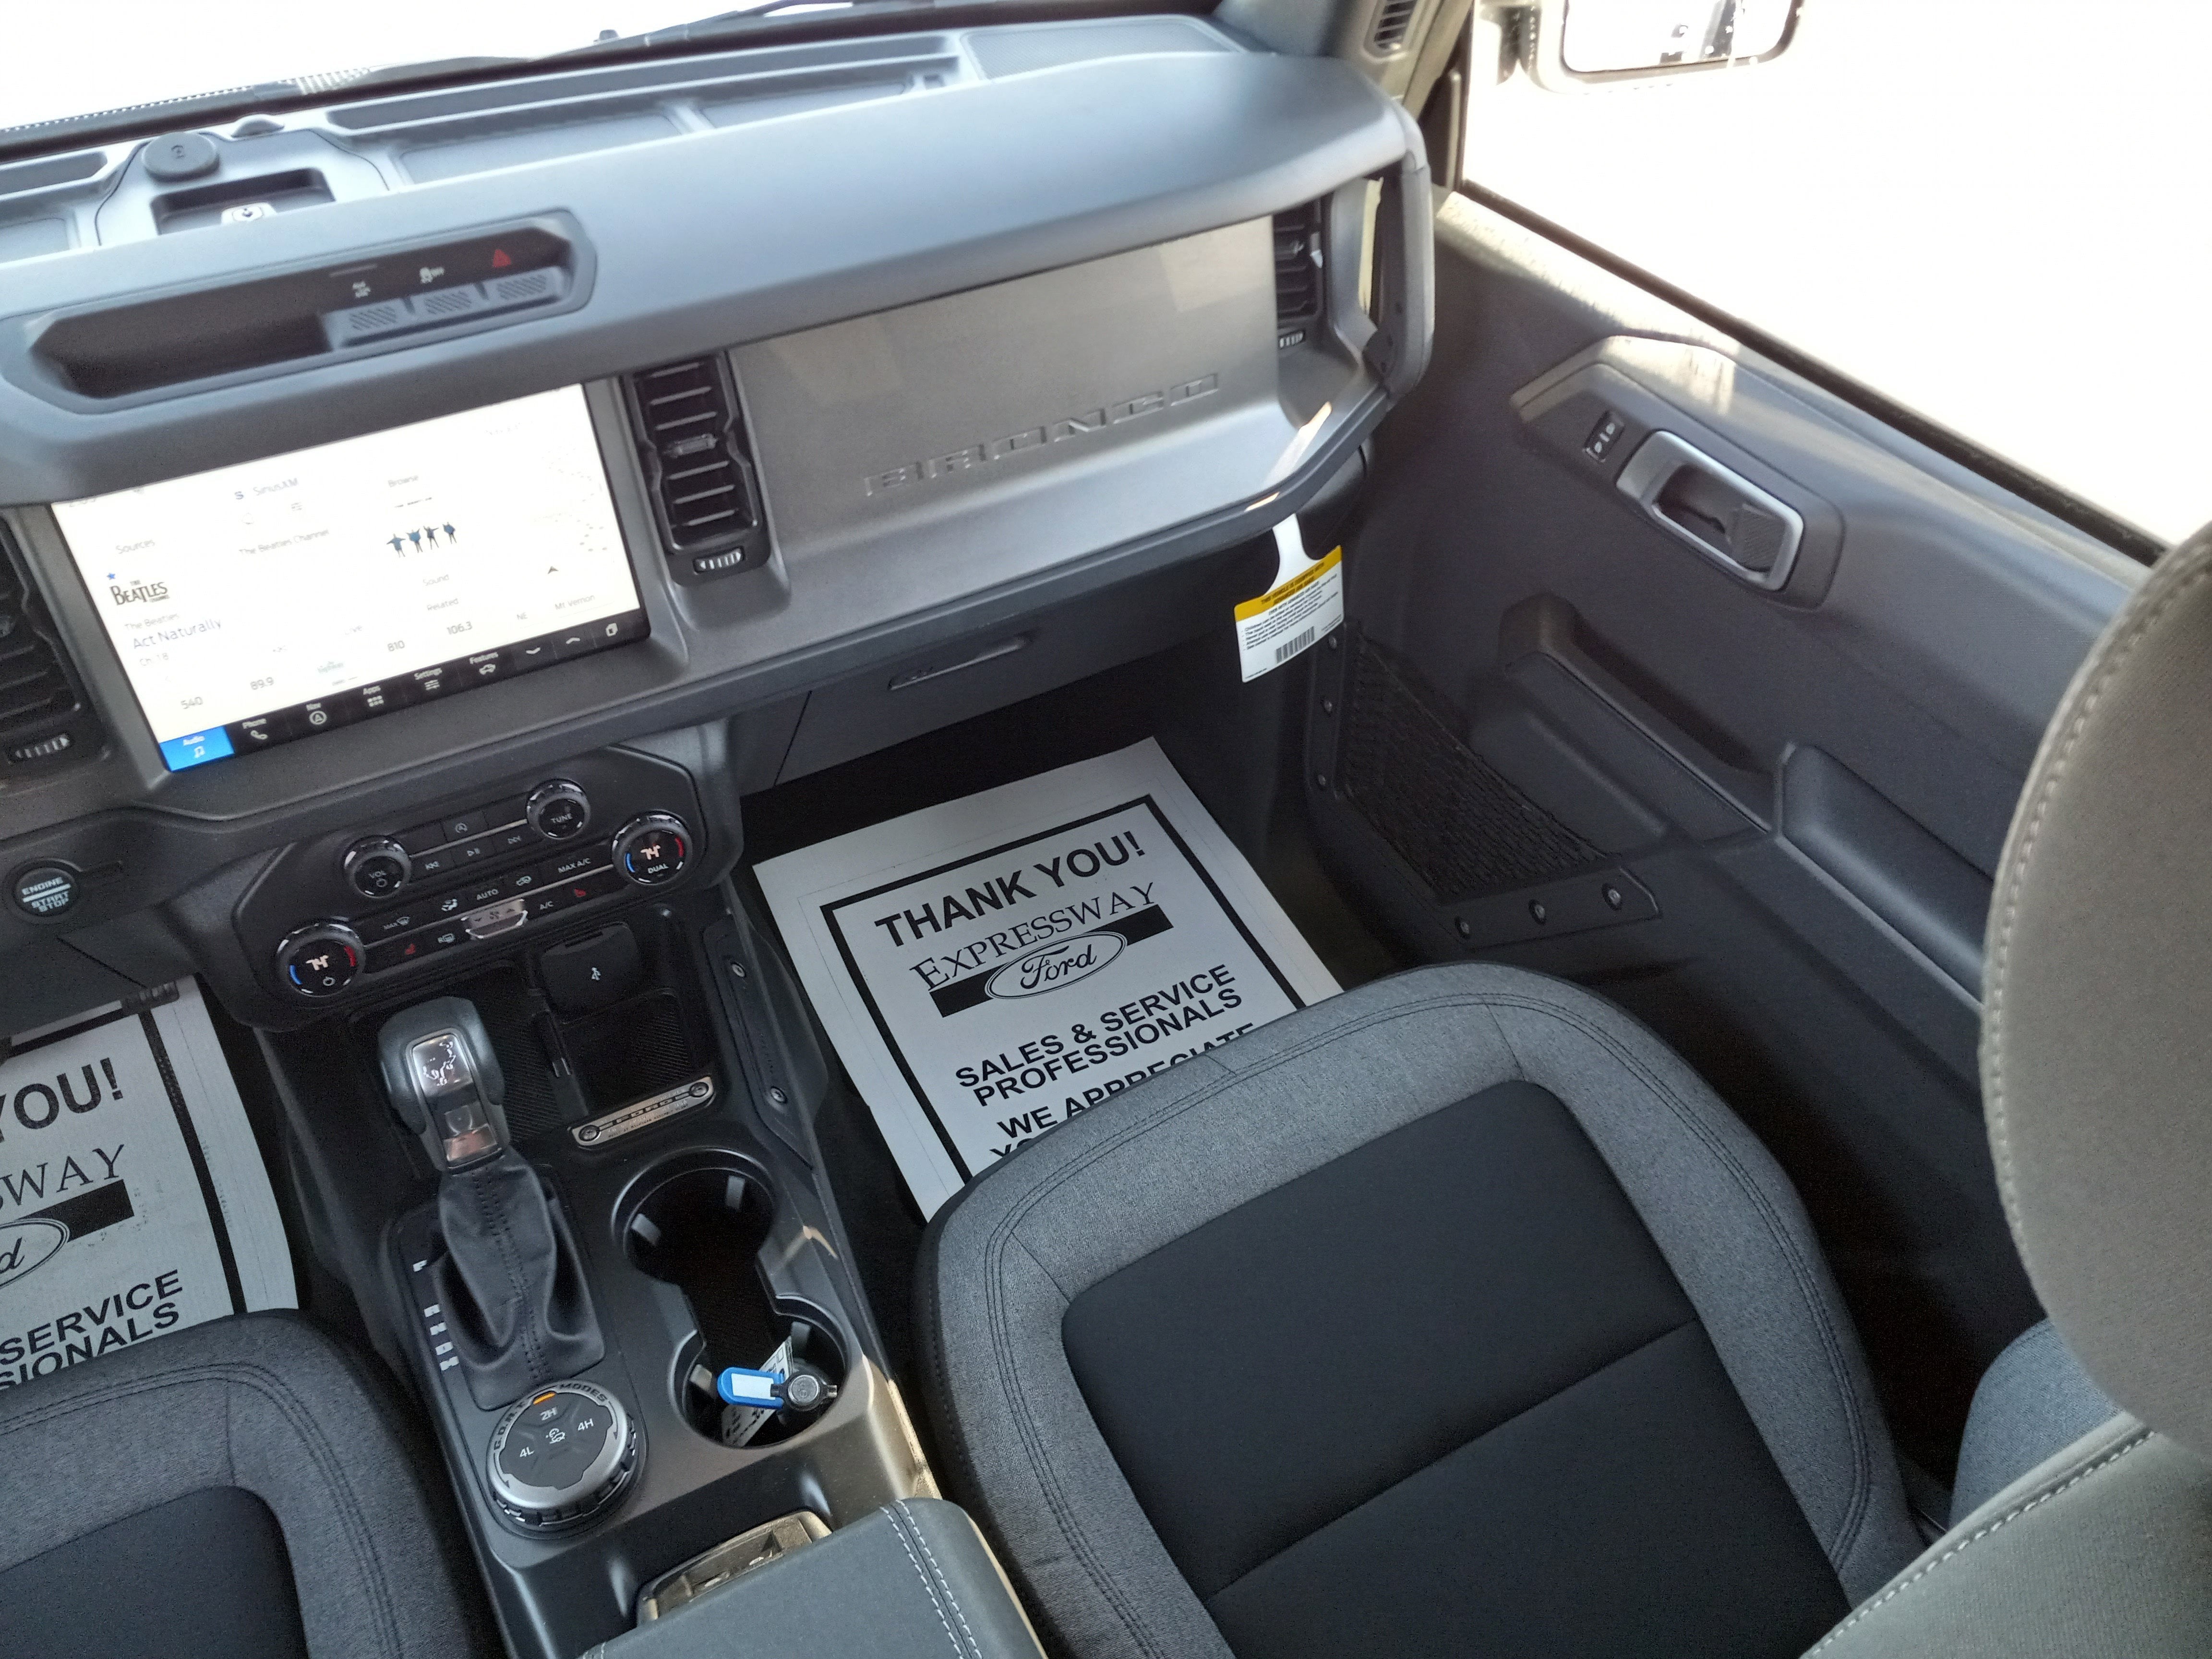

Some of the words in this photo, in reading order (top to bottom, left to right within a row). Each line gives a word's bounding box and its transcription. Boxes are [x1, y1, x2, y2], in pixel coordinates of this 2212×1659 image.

[865, 373, 1218, 497] BRONCO
[387, 474, 419, 488] Browse
[115, 538, 155, 555] Sources
[423, 574, 450, 587] Sound
[109, 581, 168, 606] BEATLES
[427, 598, 459, 612] Related
[568, 594, 596, 609] Vernon
[124, 620, 143, 631] The
[144, 612, 180, 628] Beatles
[516, 611, 528, 621] NE
[132, 635, 155, 650] Act
[157, 618, 222, 643] Naturally
[446, 621, 473, 636] 106.3
[387, 639, 406, 652] 810
[469, 651, 499, 665] Features
[414, 667, 443, 681] Settings
[249, 676, 275, 690] 89.9
[362, 685, 381, 696] Apps
[180, 696, 204, 710] 540
[306, 702, 321, 711] Nav
[242, 718, 267, 730] Phone
[183, 735, 205, 746] Audio
[550, 813, 573, 824] TUNE
[557, 863, 577, 873] MAX
[576, 857, 591, 867] A/C
[647, 863, 669, 874] DUAL
[369, 870, 387, 879] VOL
[22, 877, 64, 895] ENGINE
[875, 870, 1037, 947] THANK
[1033, 830, 1147, 888] YOU!
[31, 891, 69, 909] START
[476, 889, 499, 901] AUTO
[38, 897, 69, 913] STOP
[539, 901, 554, 910] A/C
[909, 882, 1157, 991] EXPRESSWAY
[1020, 944, 1097, 989] Ford
[955, 1034, 1065, 1087] SALES
[1070, 1023, 1097, 1044] &
[1100, 964, 1236, 1033] SERVICE
[973, 987, 1242, 1106] PROFESSIONALS
[0, 1057, 123, 1143] OU!
[996, 1106, 1058, 1139] WE
[0, 1144, 125, 1210] WAY
[0, 1269, 183, 1365] SERVICE
[558, 1382, 608, 1403] MODES
[540, 1407, 558, 1421] 2H
[577, 1418, 594, 1432] 4H
[519, 1446, 535, 1458] 4L
